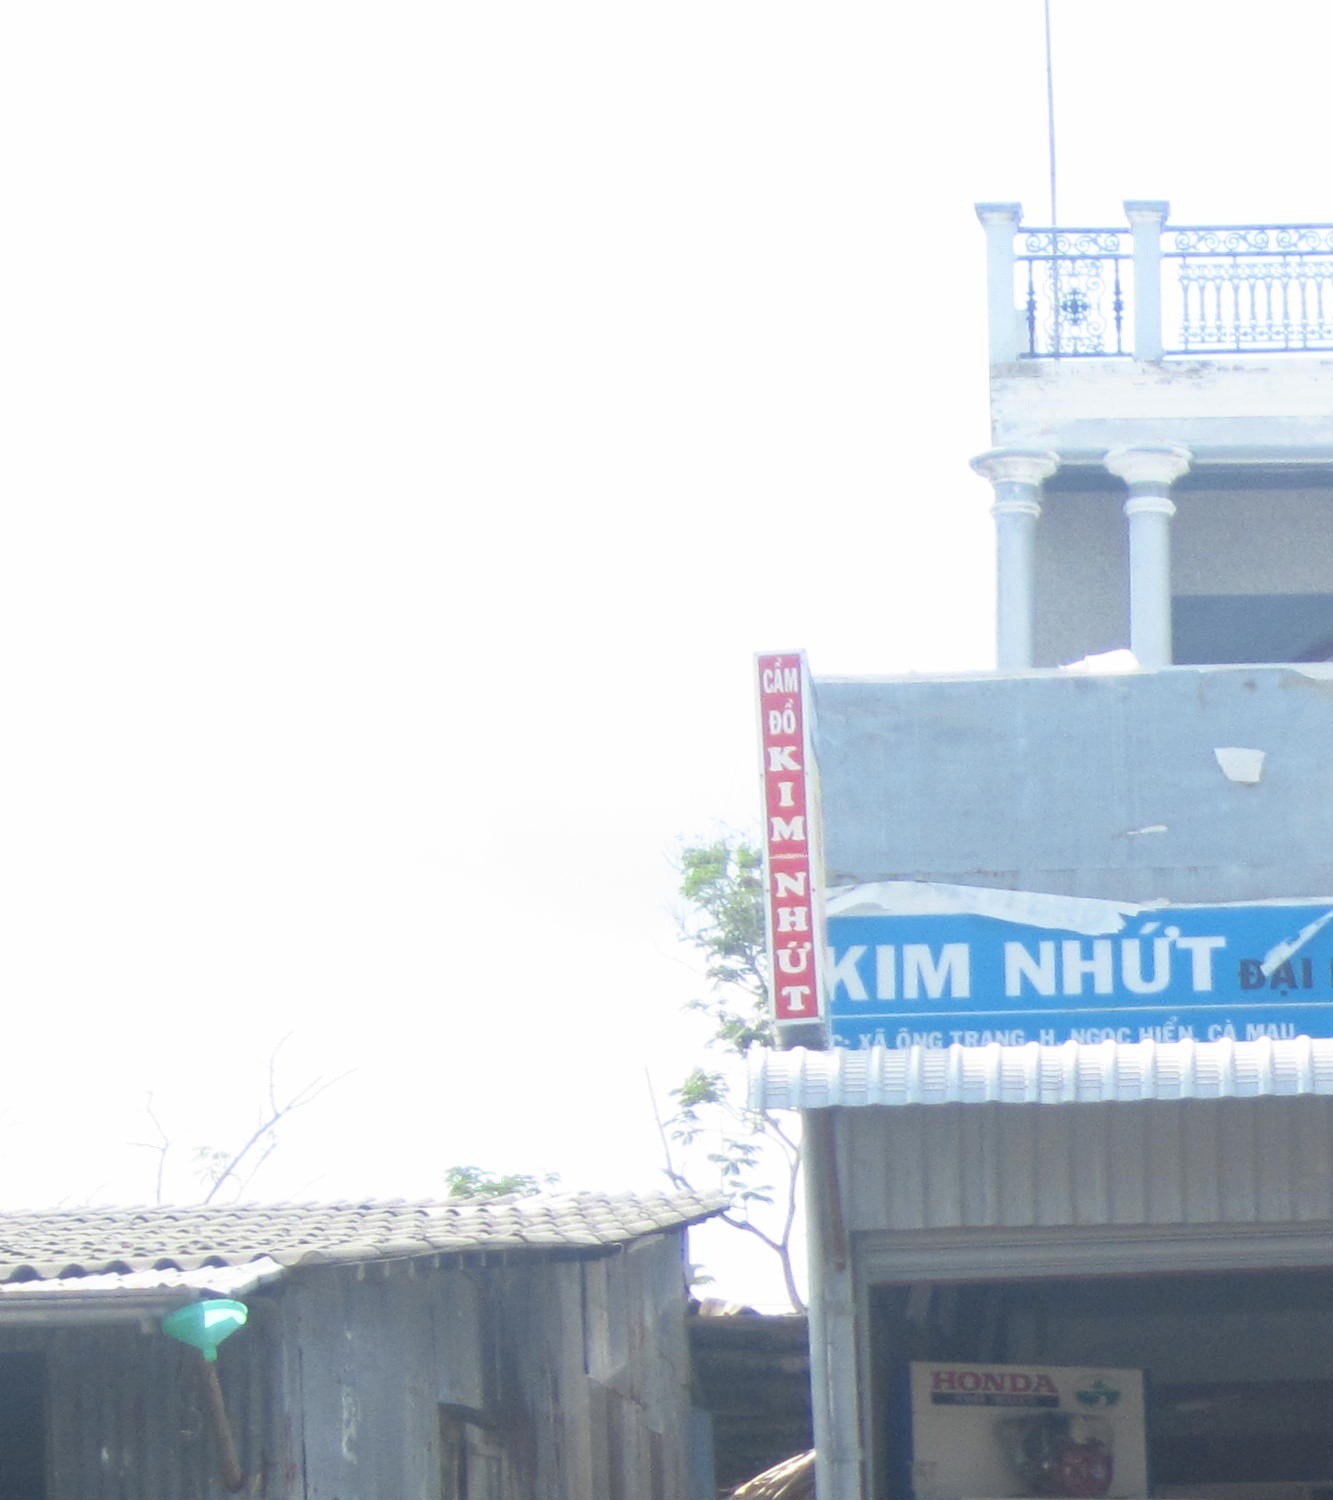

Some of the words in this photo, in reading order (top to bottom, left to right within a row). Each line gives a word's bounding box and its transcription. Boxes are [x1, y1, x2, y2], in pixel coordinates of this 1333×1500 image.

[763, 657, 799, 695] CẦM
[769, 699, 797, 735] ĐỒ
[767, 746, 806, 842] KIM
[775, 872, 811, 1011] NHỨT
[826, 943, 970, 1000] KIM
[1004, 922, 1226, 996] NHỨT
[1239, 957, 1312, 996] ĐẠI
[931, 1371, 1060, 1394] HONDA
